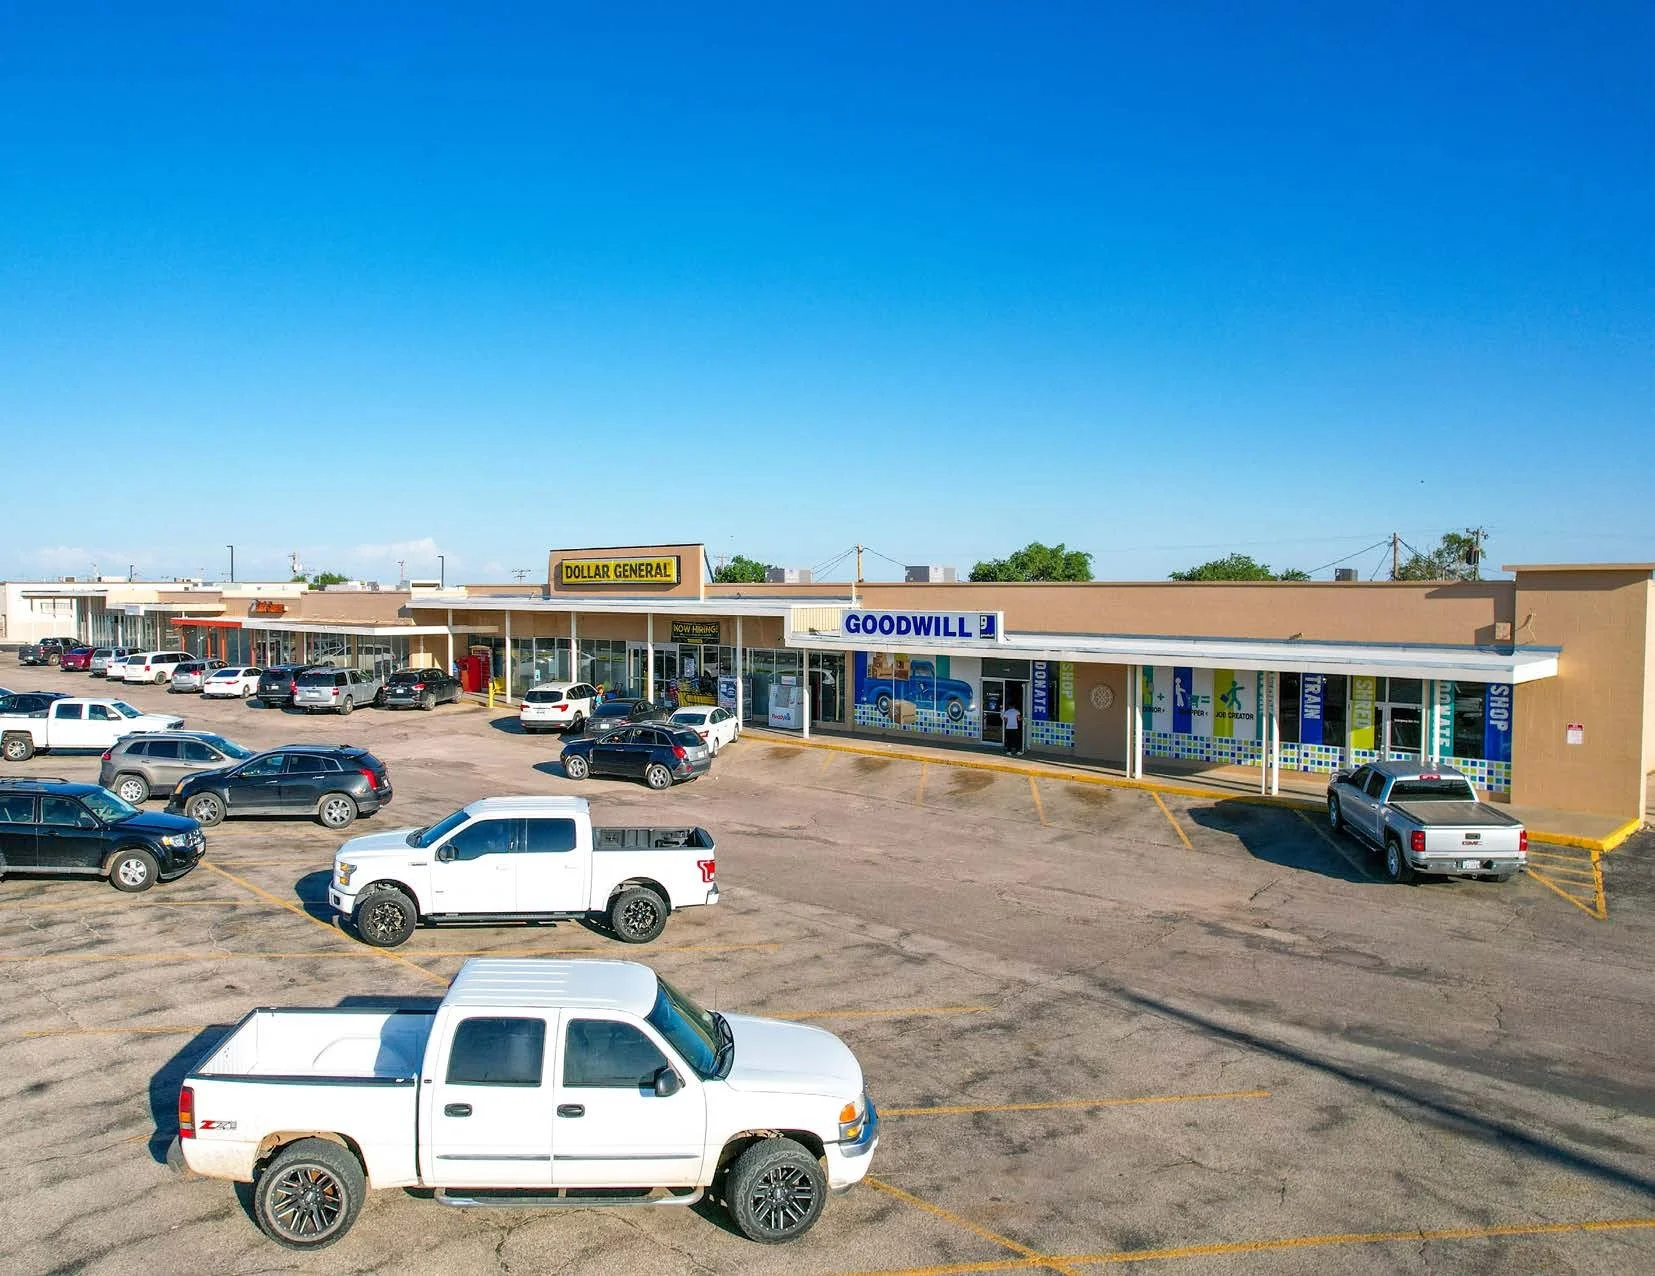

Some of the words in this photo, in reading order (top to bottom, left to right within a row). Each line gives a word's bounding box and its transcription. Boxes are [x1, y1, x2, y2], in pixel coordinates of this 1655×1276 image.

[565, 564, 611, 579] DOLLAR
[613, 562, 671, 578] GENERAL
[673, 624, 690, 633] NOW
[845, 614, 972, 638] GOODWILL
[1034, 661, 1047, 713] DONATE
[1062, 662, 1074, 699] SHOP
[1304, 675, 1321, 720] TRAIN
[1440, 681, 1452, 748] DONATE
[1490, 685, 1510, 731] SHOP
